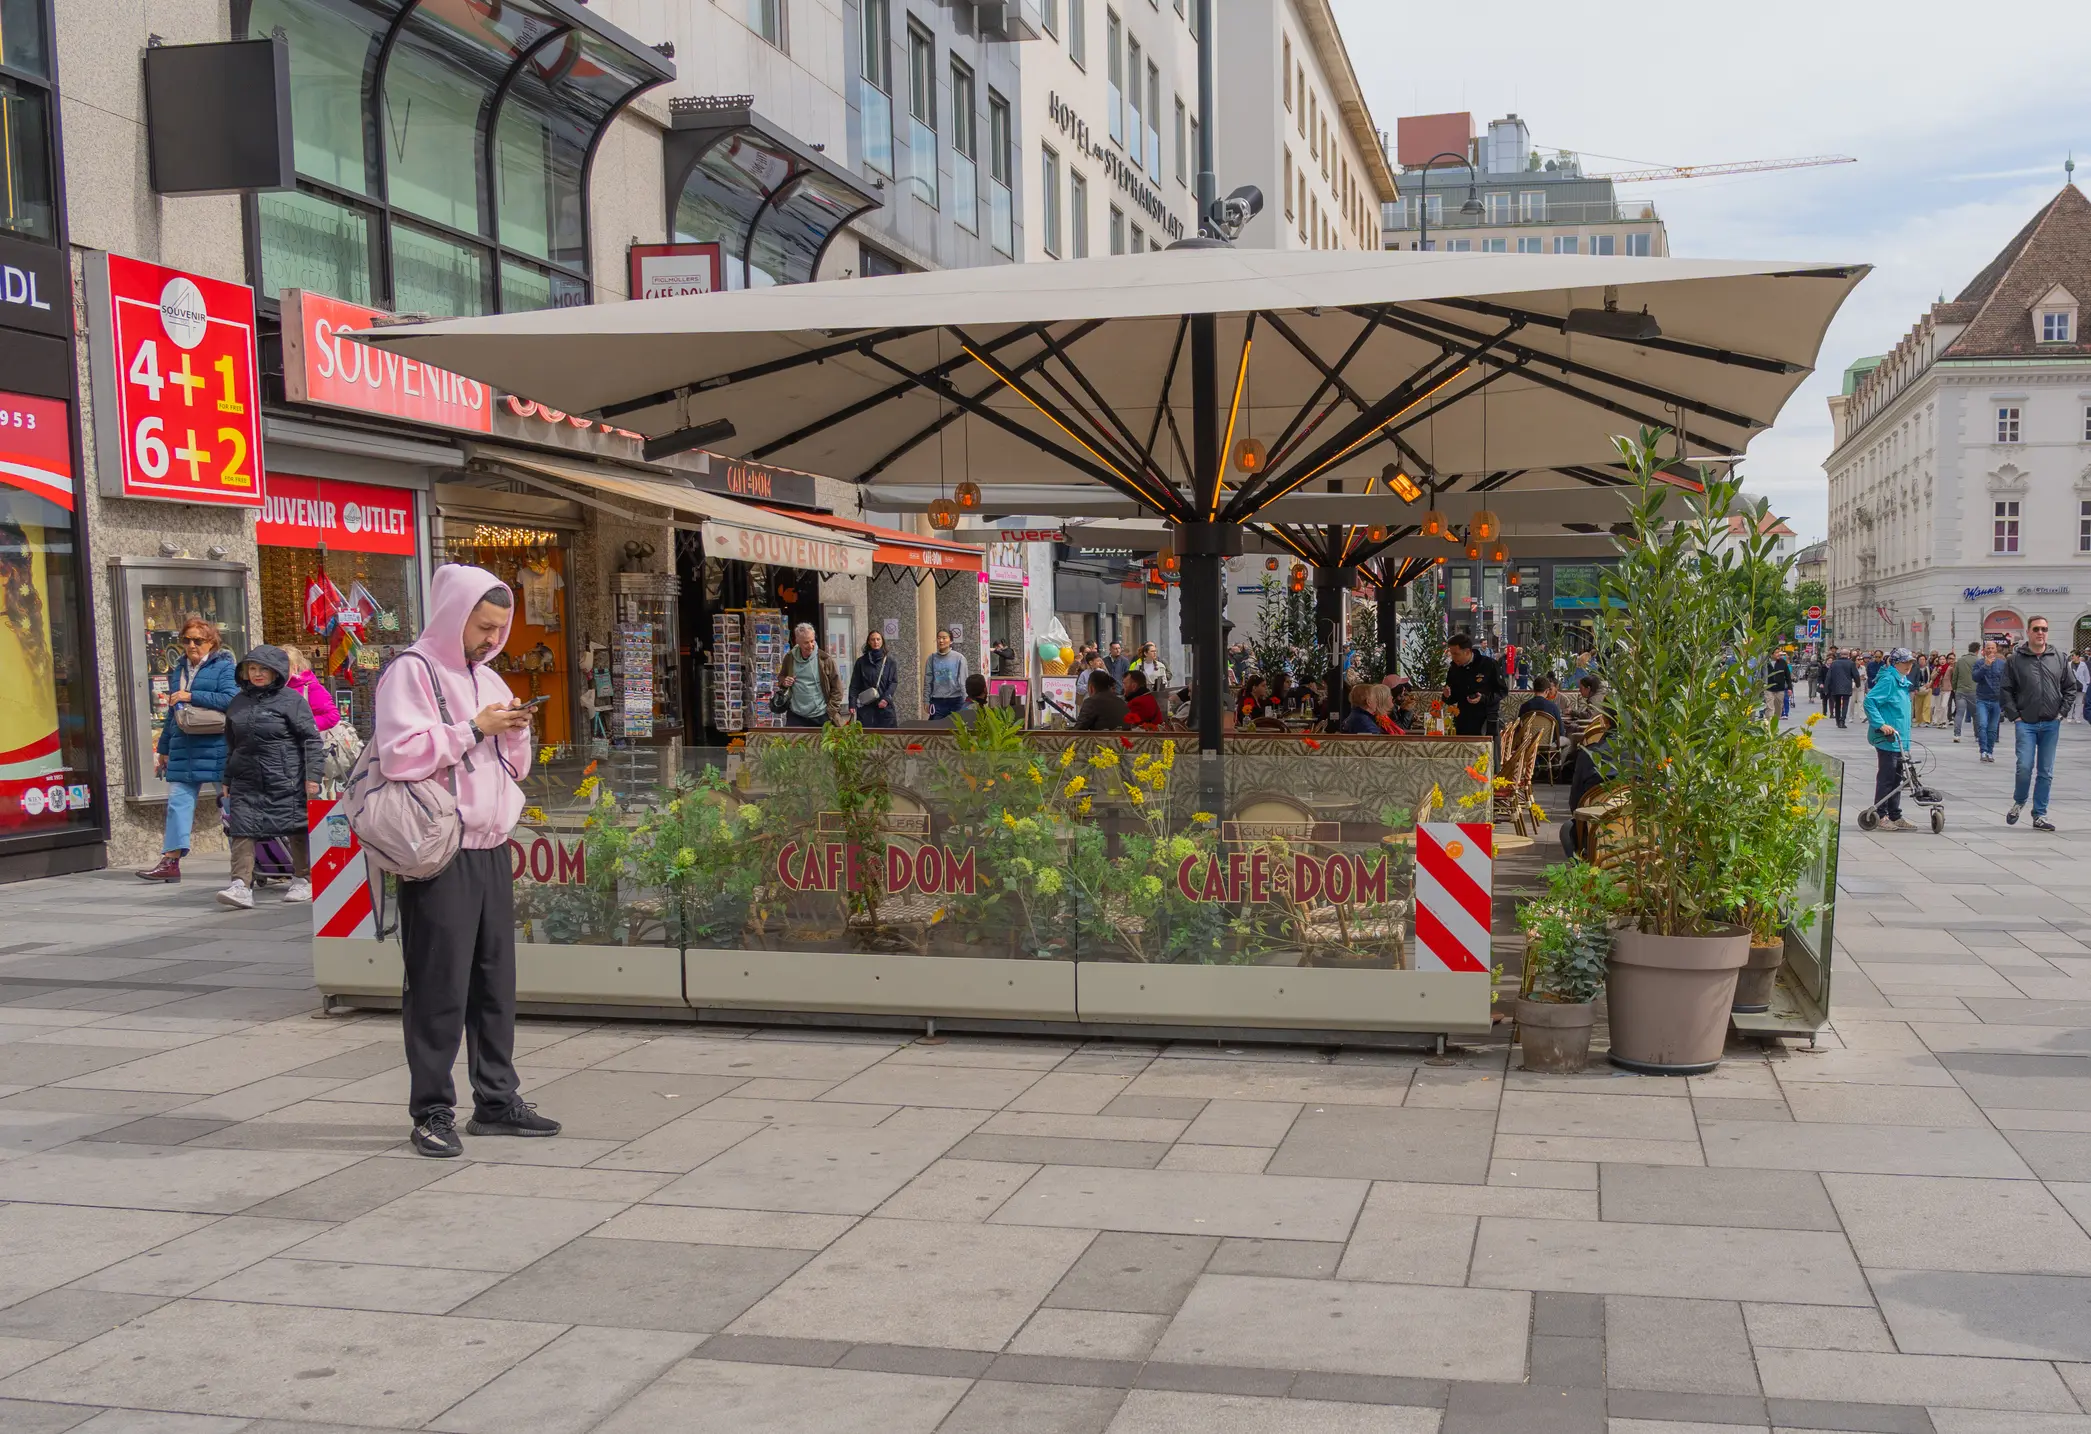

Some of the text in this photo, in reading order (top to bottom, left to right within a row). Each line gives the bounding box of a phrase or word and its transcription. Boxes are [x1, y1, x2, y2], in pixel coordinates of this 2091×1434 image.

[1050, 90, 1093, 157] HOTEL
[1104, 148, 1185, 240] STEPHANSPLATZ
[0, 265, 51, 310] DL
[161, 305, 206, 322] SOUVENIR
[738, 530, 849, 569] SOUVENIRS
[1963, 586, 2004, 600] Manner
[507, 836, 587, 885] DOM
[886, 844, 976, 895] DOM
[1177, 845, 1271, 903] CAFÉ
[1294, 852, 1388, 905] DOM
